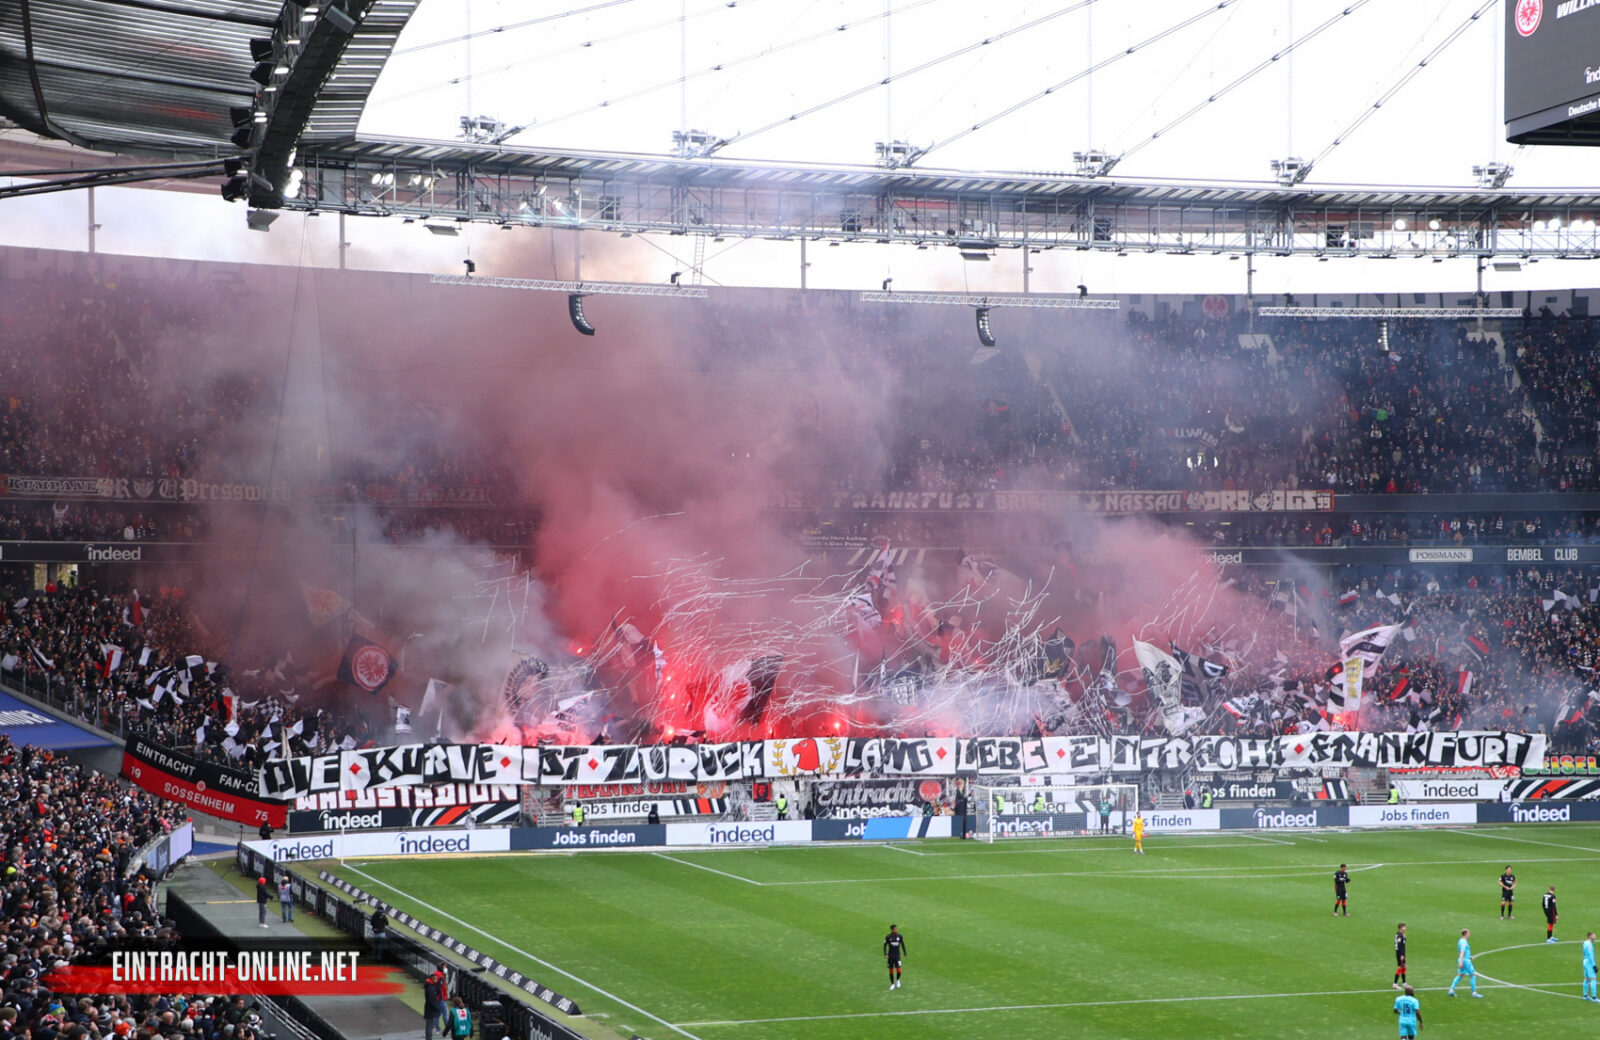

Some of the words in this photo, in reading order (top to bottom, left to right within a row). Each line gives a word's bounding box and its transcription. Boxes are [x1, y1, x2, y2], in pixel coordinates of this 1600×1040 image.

[1568, 100, 1597, 117] Deutsche
[832, 491, 986, 509] FRANKFURT
[1105, 494, 1181, 511] NASSAU
[84, 544, 141, 560] indeed
[1416, 551, 1467, 559] POSSMANN
[1507, 548, 1543, 561] BEMBEL
[1554, 548, 1578, 561] CLUB
[136, 741, 196, 777] EINTRACHT
[263, 755, 340, 795] DIE
[361, 744, 497, 788] KURVE
[523, 746, 590, 781] IST
[603, 742, 764, 782] ZURÜCK
[846, 738, 933, 772] LANG
[957, 737, 1048, 772] LEBE
[1308, 732, 1527, 766] FRANKFURT
[131, 766, 142, 779] 19
[164, 782, 235, 814] SOSSENHEIM
[255, 810, 268, 821] 75
[818, 781, 915, 806] Eintracht
[1230, 784, 1276, 798] finden
[1420, 782, 1479, 797] indeed
[583, 803, 608, 815] obs
[612, 800, 651, 814] finde
[1380, 809, 1408, 822] Jobs
[1411, 808, 1450, 821] finden
[1509, 802, 1570, 822] indeed
[320, 810, 382, 830] indeed
[988, 815, 1053, 832] indeed
[1152, 815, 1192, 827] finden
[1254, 808, 1317, 827] indeed
[395, 832, 470, 853] indeed
[552, 831, 586, 845] Jobs
[590, 829, 636, 844] finden
[706, 824, 775, 844] indeed
[269, 839, 333, 861] indeed
